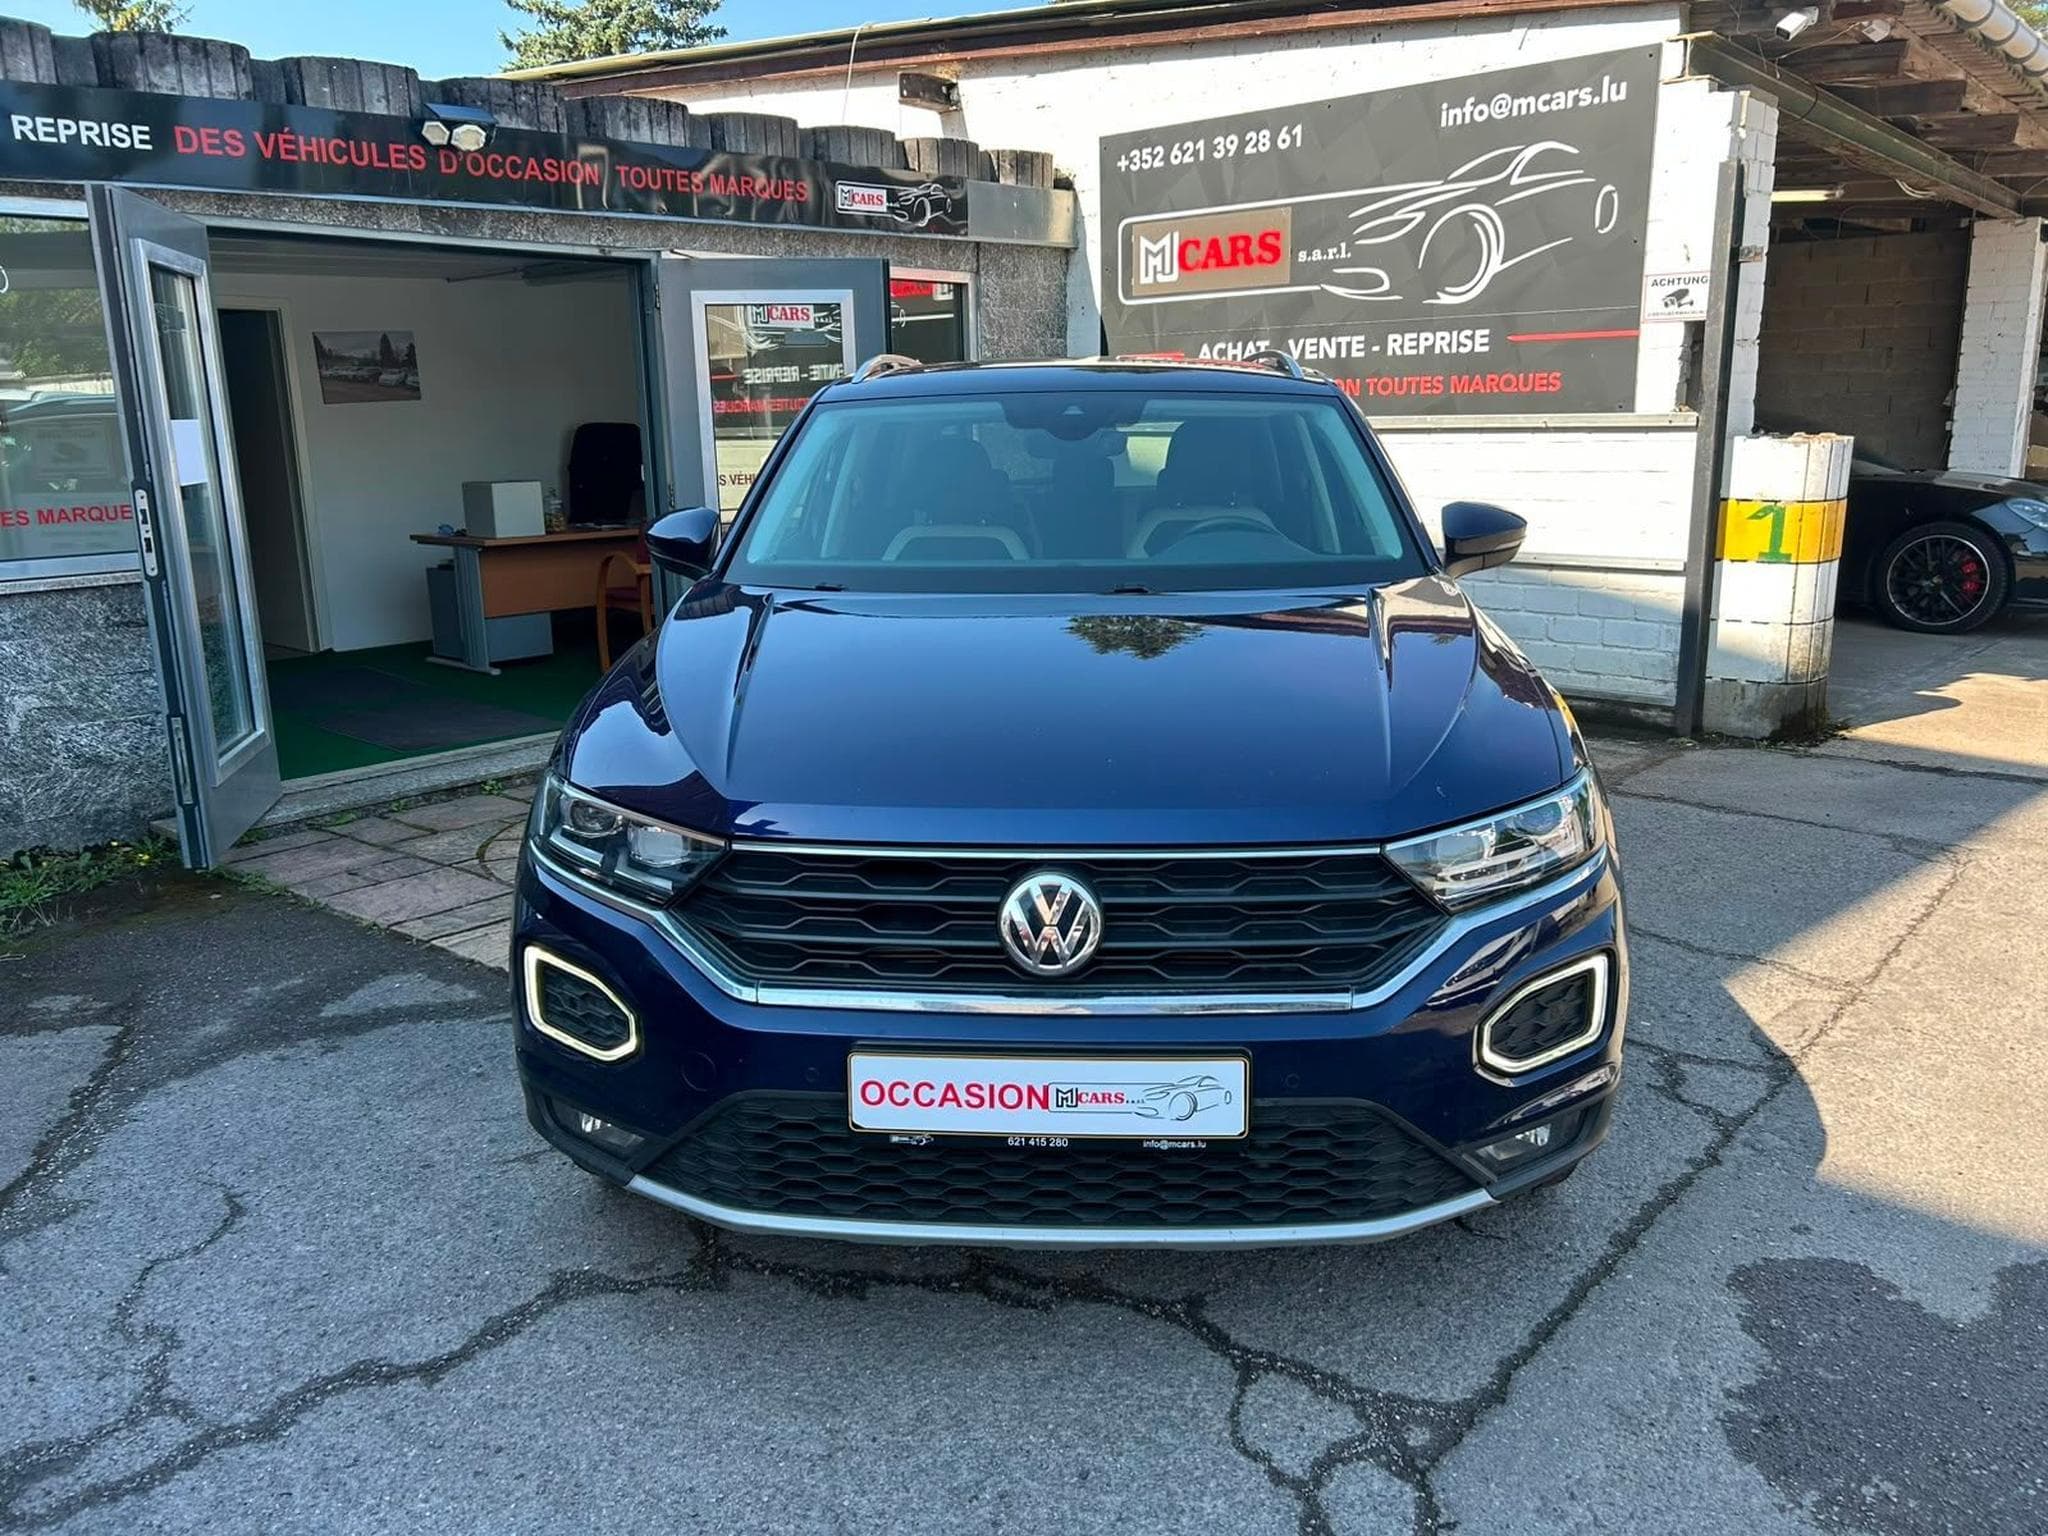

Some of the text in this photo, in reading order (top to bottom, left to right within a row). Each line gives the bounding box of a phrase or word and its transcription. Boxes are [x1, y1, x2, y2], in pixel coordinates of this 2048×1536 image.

[1440, 75, 1628, 128] info@mcars.lu
[10, 114, 809, 202] REPRISE DES VÉHICULES D'OCCASION TOUTES MARQUES
[1116, 123, 1303, 173] +352 621 39 28 61
[1298, 243, 1352, 263] s.a.r.l.
[1651, 276, 1709, 287] ACHTUNG
[1288, 335, 1366, 360] VENTE
[1387, 329, 1491, 354] REPRISE
[1367, 375, 1445, 396] TOUTES
[1450, 371, 1563, 394] MARQUES
[1746, 504, 1793, 564] 1
[860, 1080, 1050, 1110] OCCASION
[1008, 1136, 1069, 1147] 621 415 280
[1143, 1139, 1207, 1150] info@mcars.lu
